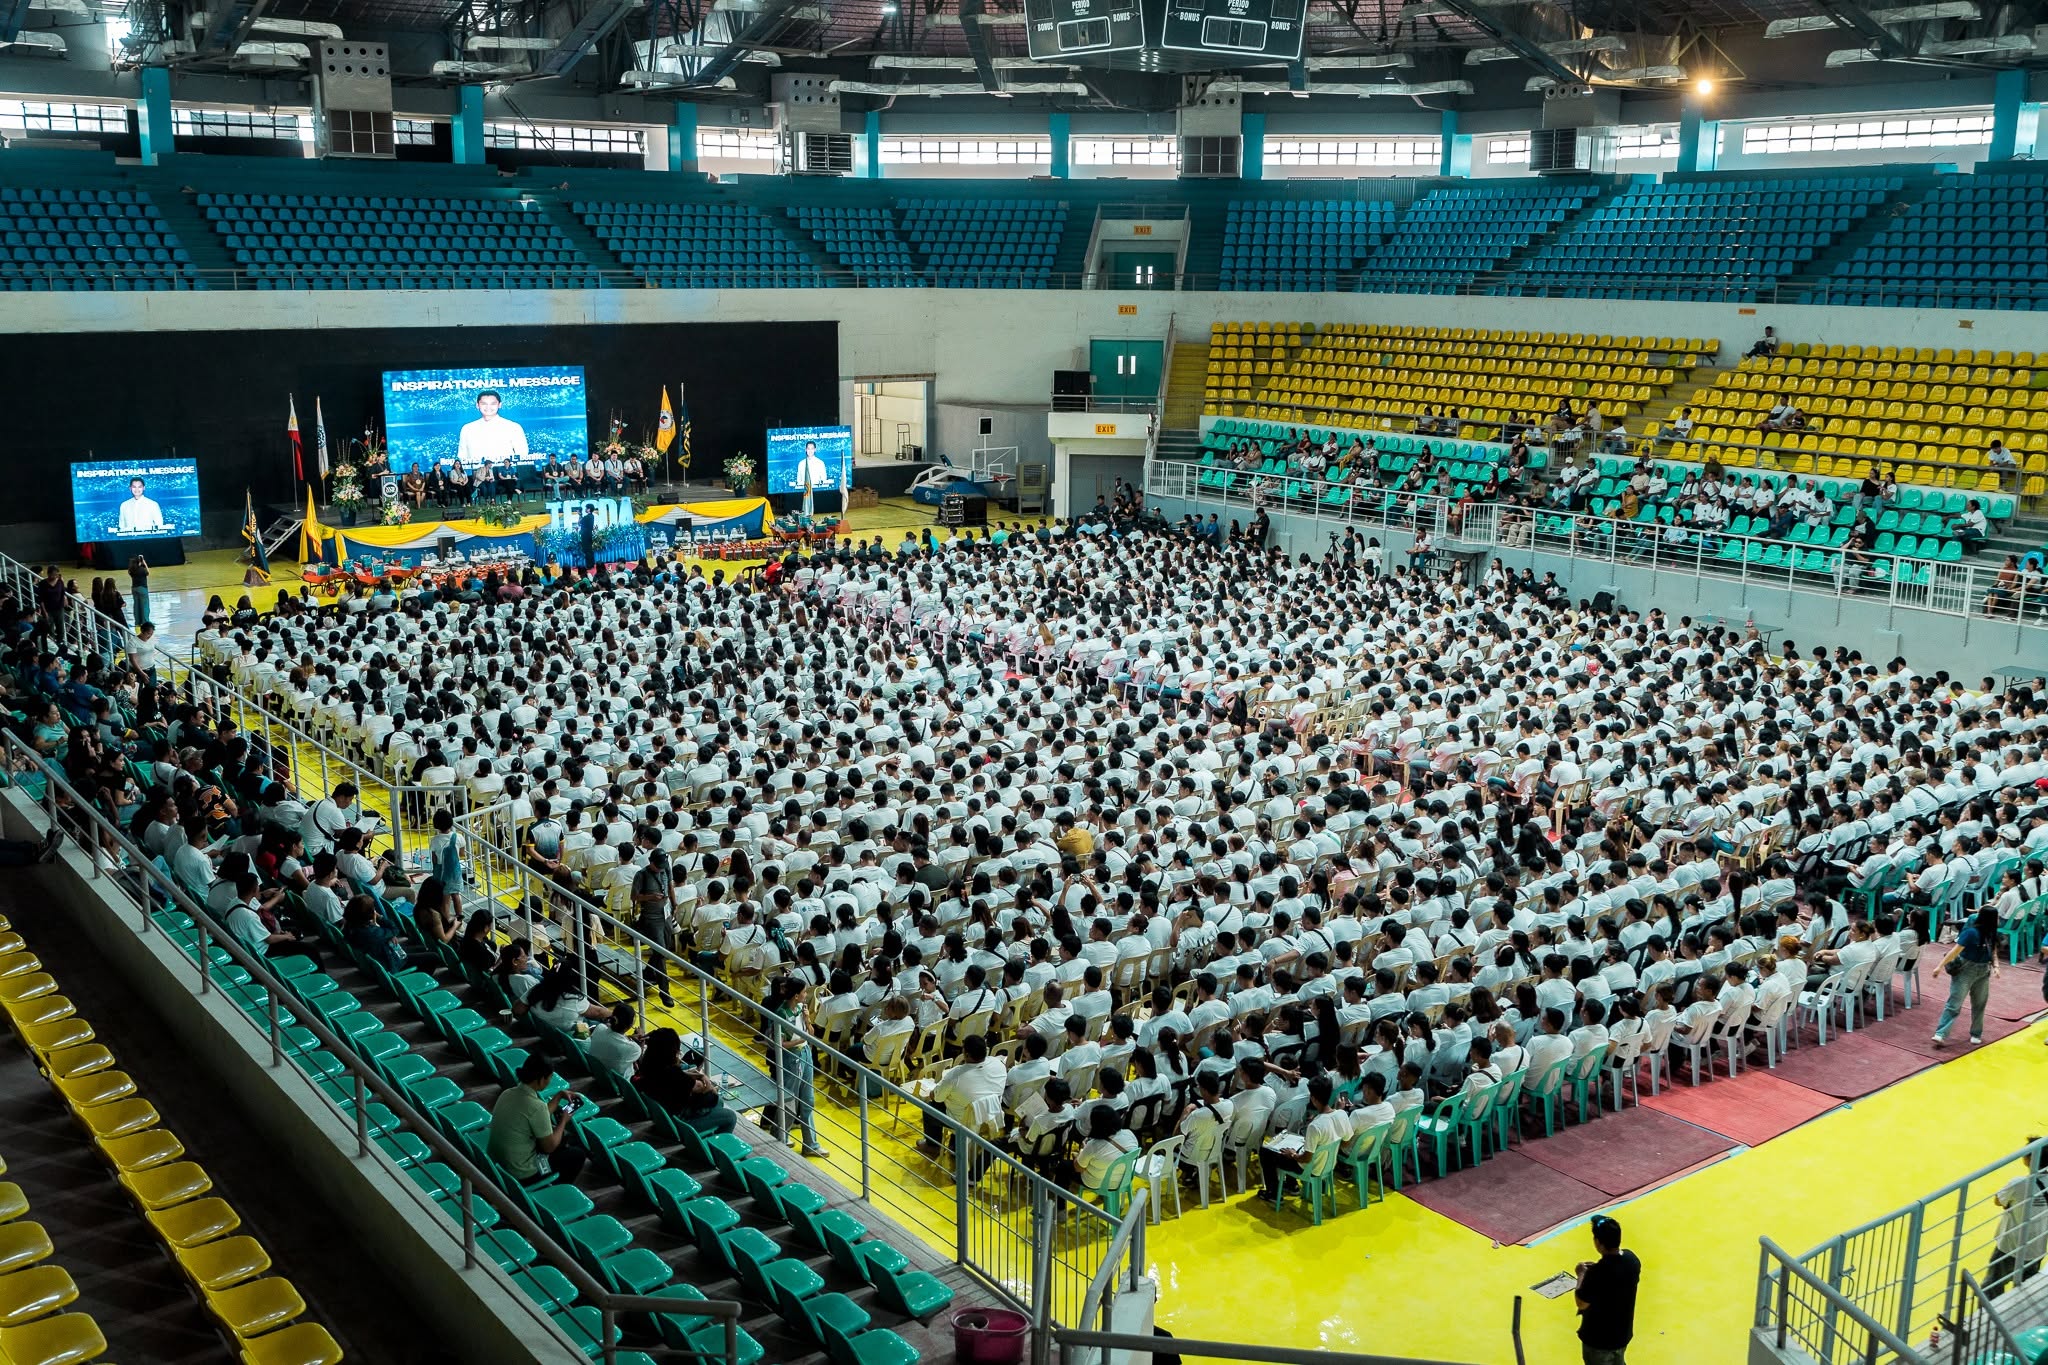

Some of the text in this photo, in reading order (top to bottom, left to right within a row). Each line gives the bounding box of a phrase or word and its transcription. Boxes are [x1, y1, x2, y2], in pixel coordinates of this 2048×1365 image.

[1072, 0, 1090, 9] PERIOD
[1228, 0, 1250, 8] PERIOD
[1113, 12, 1131, 22] BONUS
[1180, 12, 1200, 22] BONUS
[1037, 22, 1054, 32] BONUS
[1271, 21, 1291, 31] BONUS
[1119, 306, 1136, 314] EXIT
[392, 376, 580, 390] INSPIRATIONAL MESSAGE
[1097, 425, 1115, 434] EXIT
[77, 466, 194, 477] INSPIRATIONAL MESSAGE
